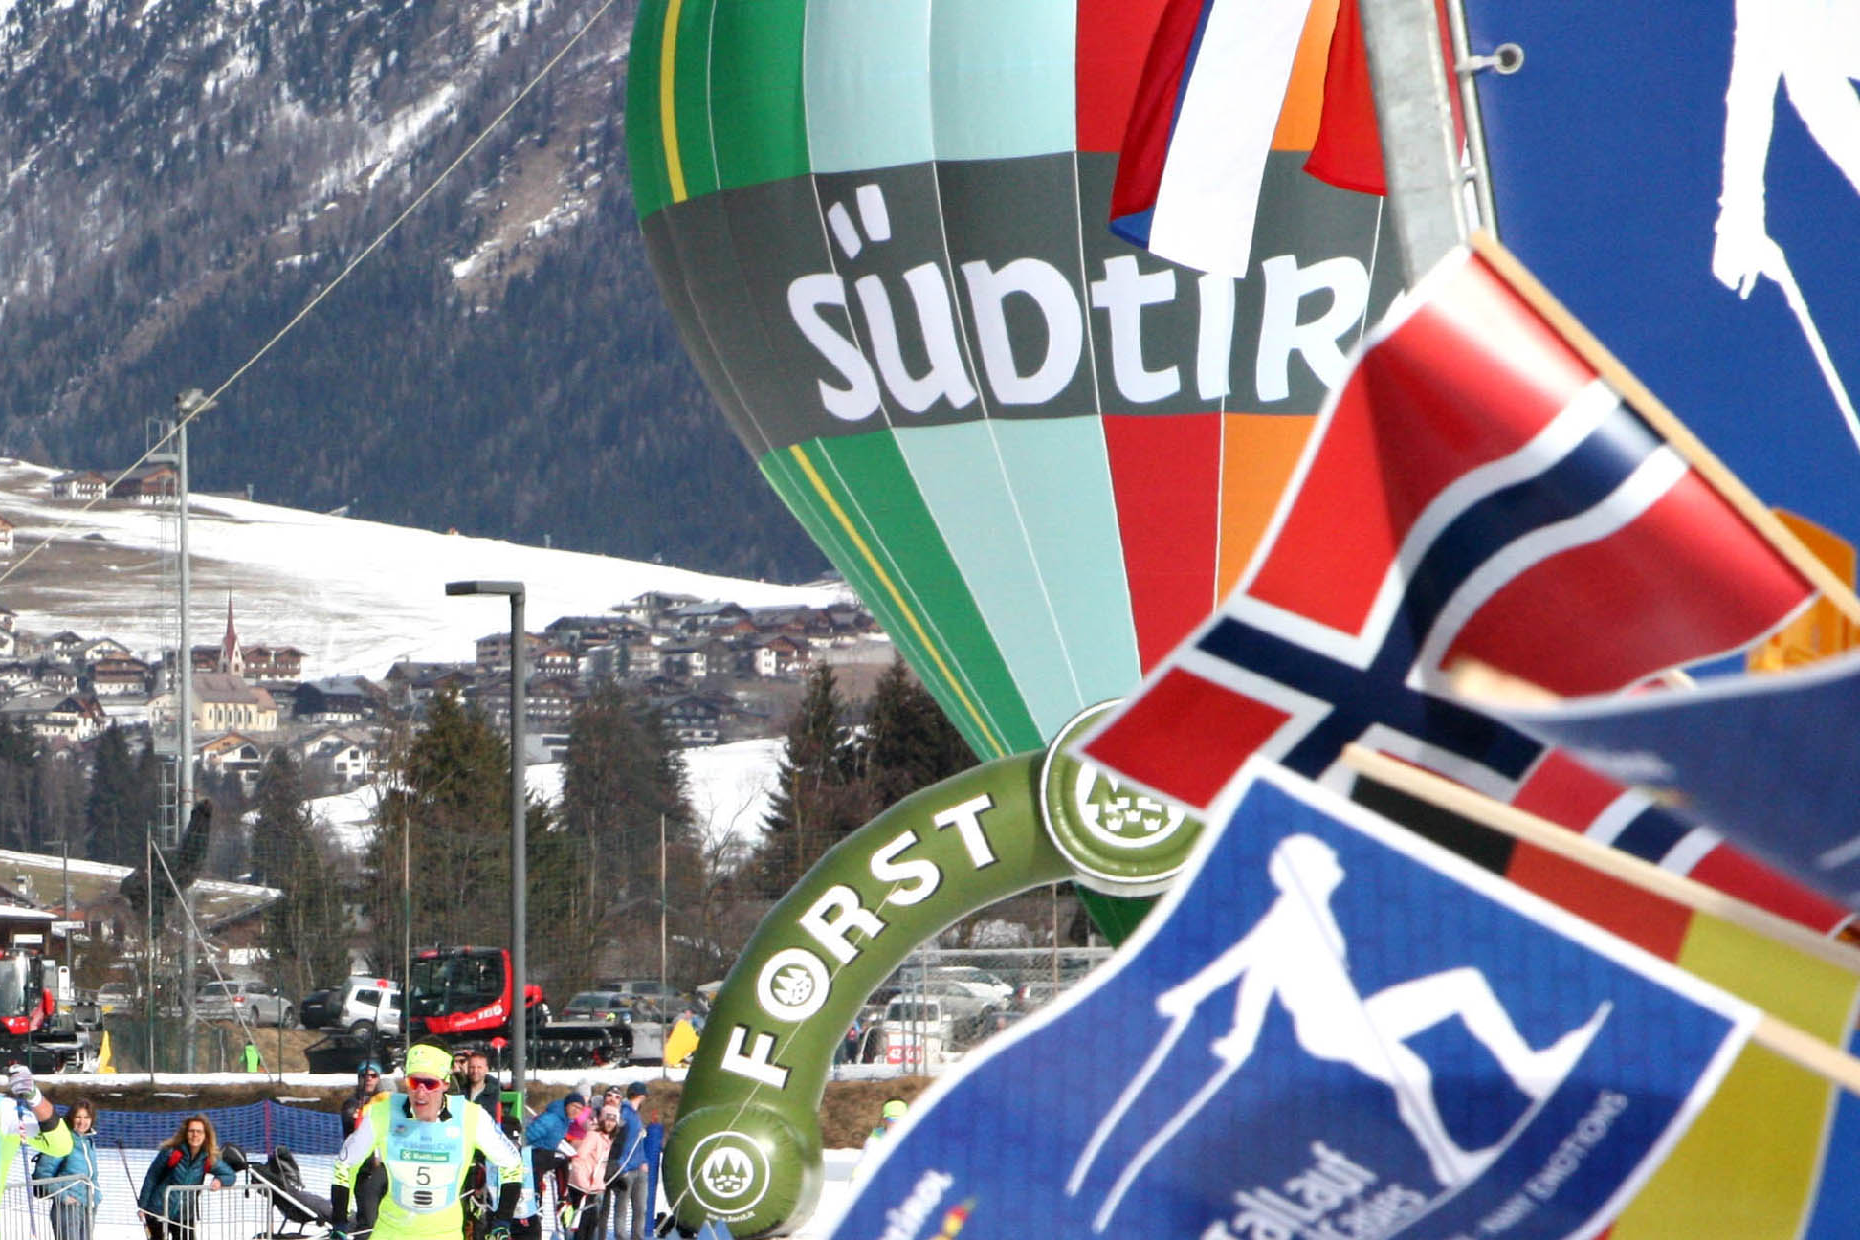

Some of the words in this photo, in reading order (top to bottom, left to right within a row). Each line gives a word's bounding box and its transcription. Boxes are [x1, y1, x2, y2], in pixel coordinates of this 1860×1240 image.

[720, 794, 998, 1090] FORST
[415, 1165, 431, 1186] 5
[1524, 1089, 1630, 1201] EMOTIONS
